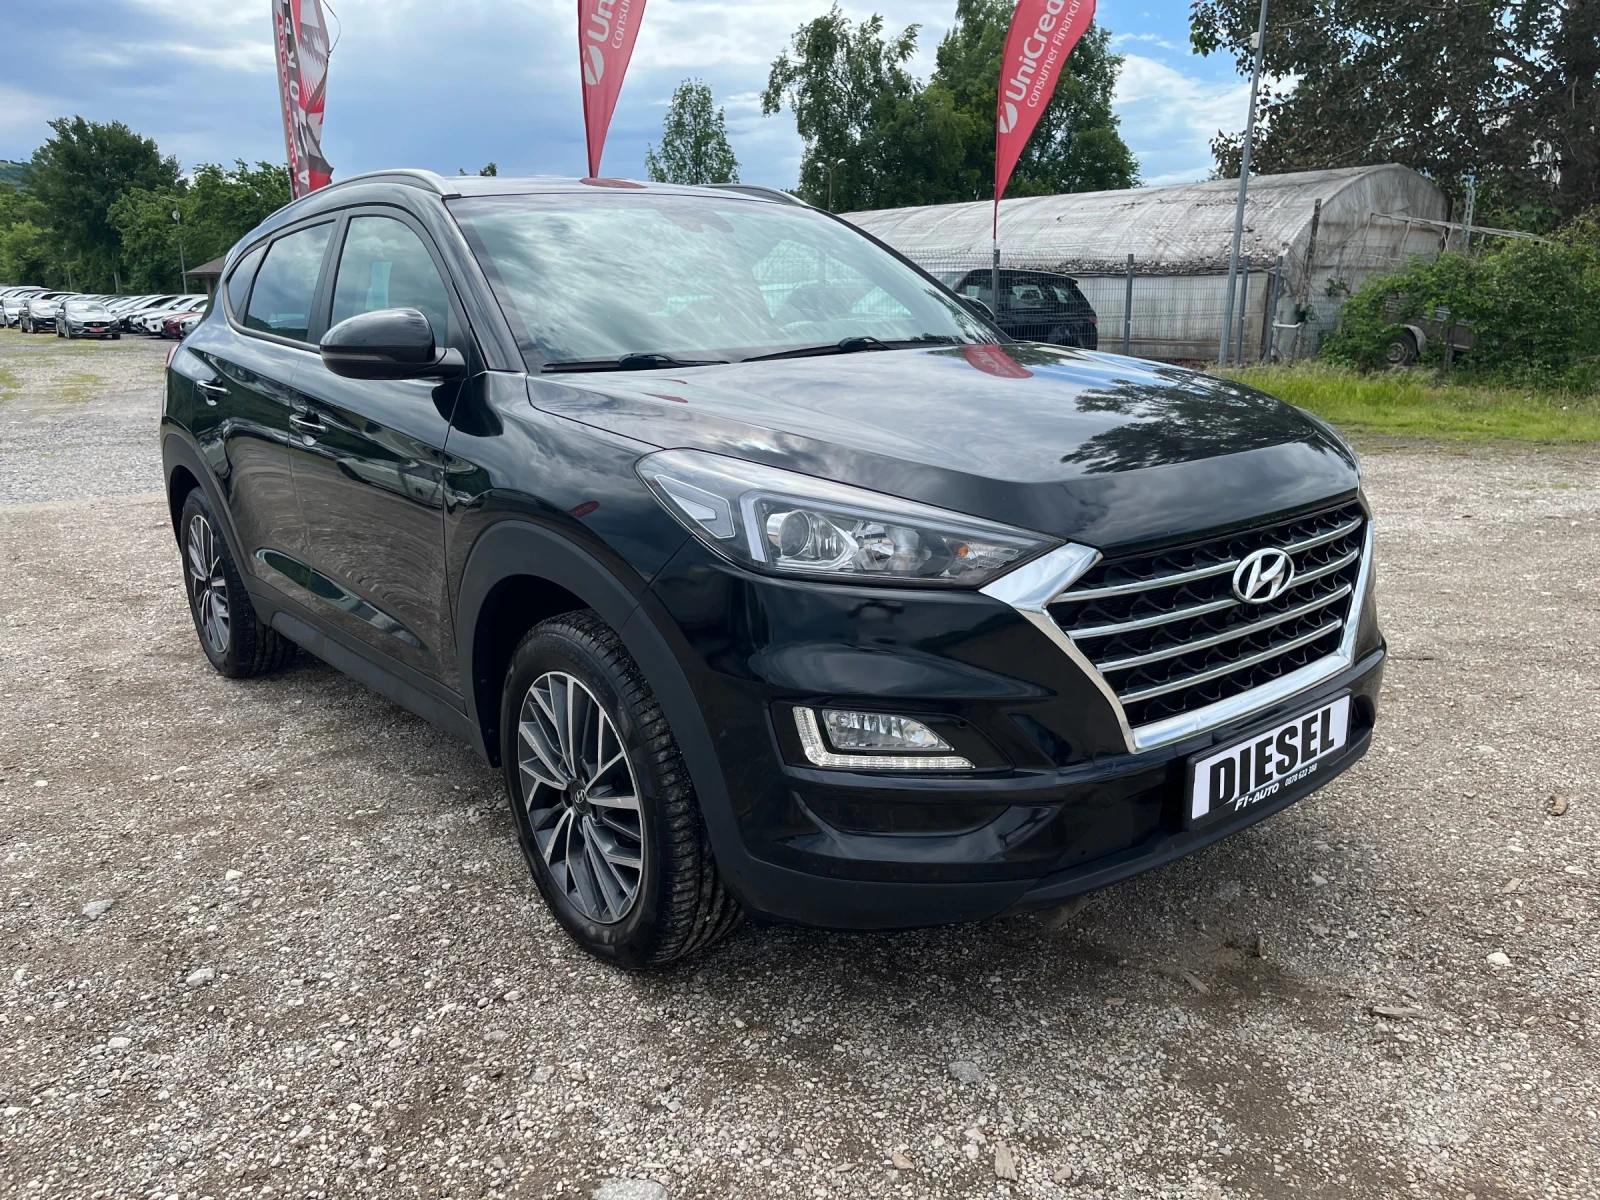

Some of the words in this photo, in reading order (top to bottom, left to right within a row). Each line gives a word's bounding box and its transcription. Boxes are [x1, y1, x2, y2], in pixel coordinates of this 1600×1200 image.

[611, 0, 630, 49] Consu
[1026, 46, 1059, 108] Consumer
[1208, 707, 1335, 812] DIESEL
[1234, 782, 1280, 811] F1-AUTO
